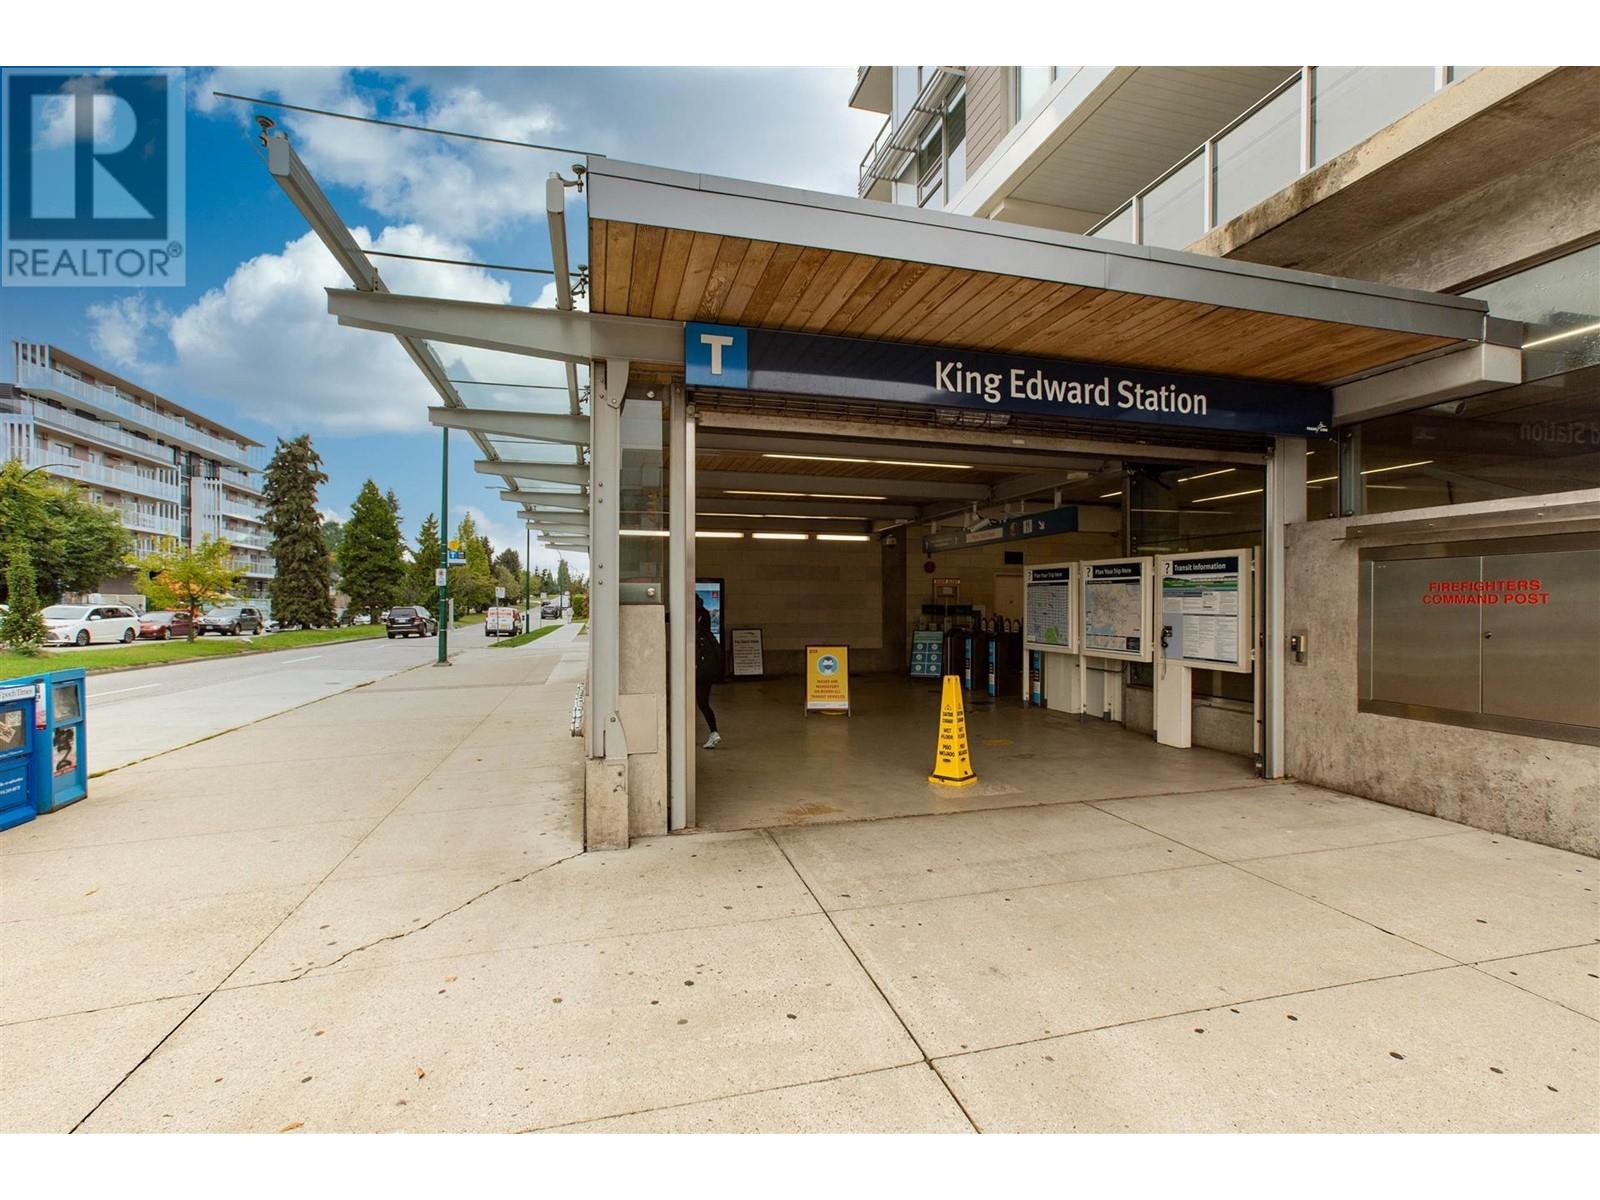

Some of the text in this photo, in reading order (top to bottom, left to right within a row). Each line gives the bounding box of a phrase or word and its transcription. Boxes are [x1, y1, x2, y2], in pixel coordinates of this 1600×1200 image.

[701, 334, 733, 375] T
[935, 360, 1207, 416] King Edward Station
[1174, 563, 1192, 571] Transit
[1193, 561, 1226, 571] Information
[1429, 579, 1540, 592] FIREFIGHTERS
[1423, 592, 1549, 605] COMMAND POST
